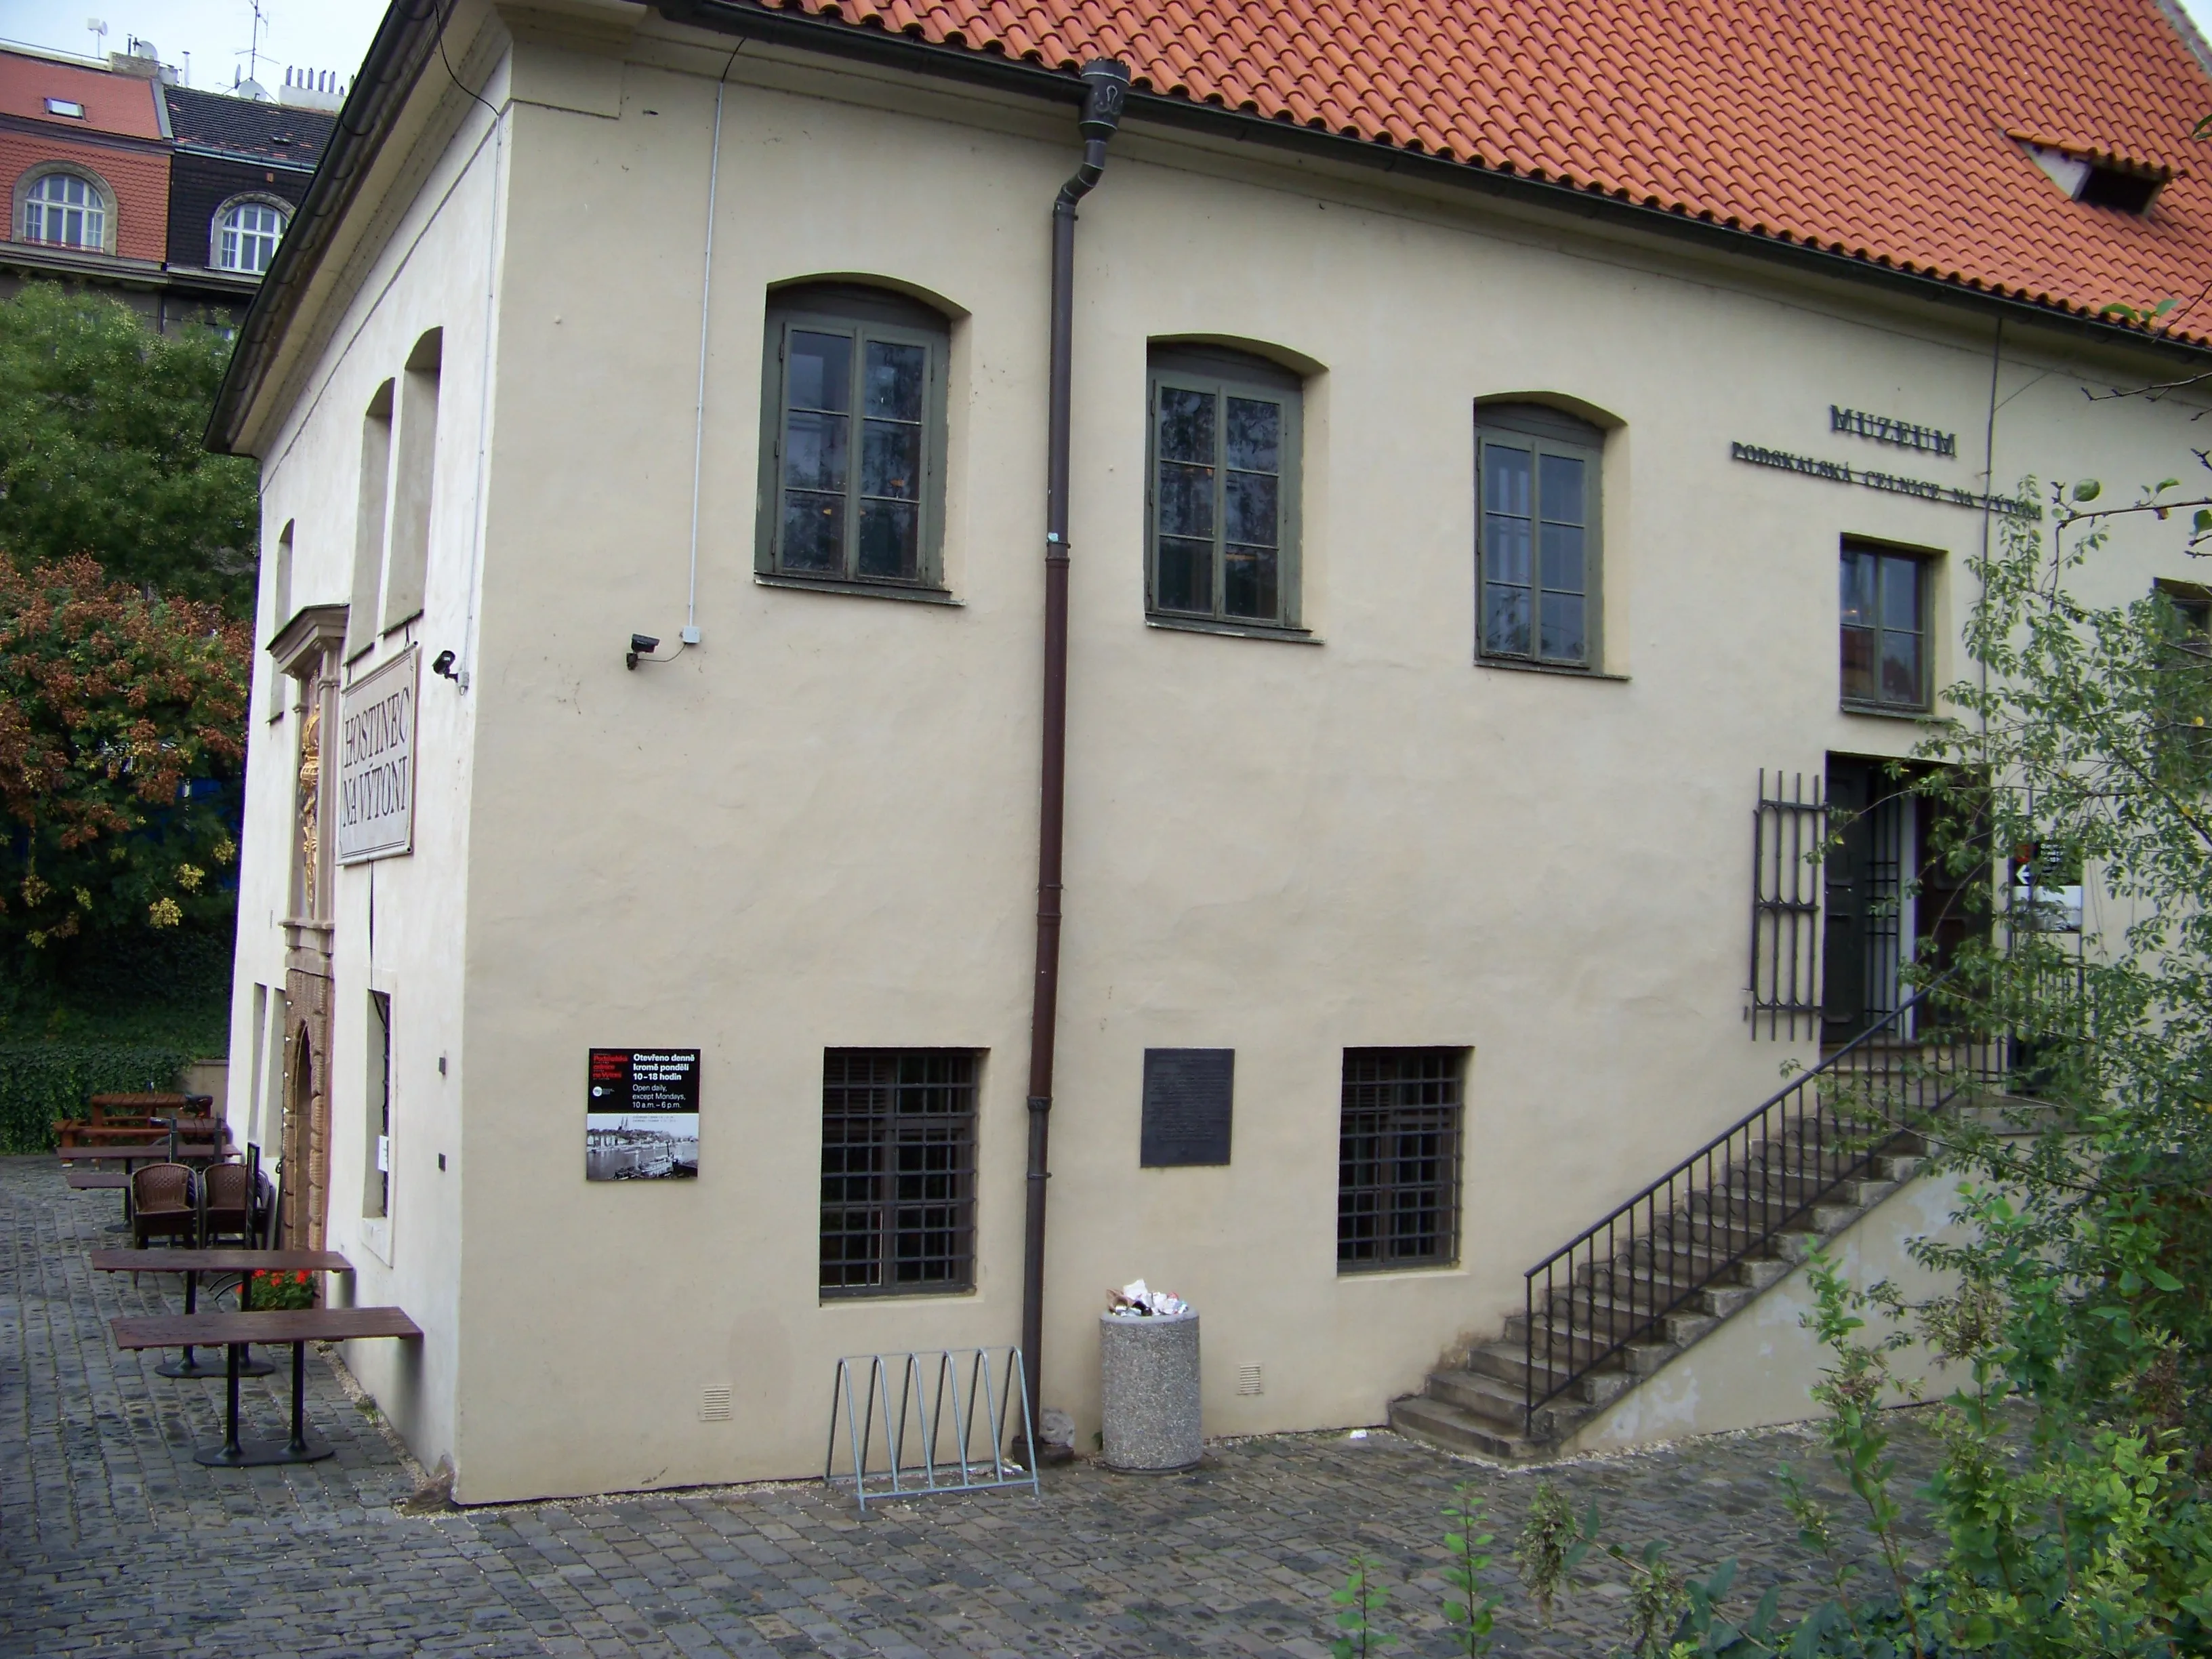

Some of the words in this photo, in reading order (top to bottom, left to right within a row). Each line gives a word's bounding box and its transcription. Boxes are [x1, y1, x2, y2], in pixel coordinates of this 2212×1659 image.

[1830, 404, 1957, 458] MUZEUM
[1732, 441, 1852, 484] PODSKALSKÁ
[1864, 470, 1940, 500] CELNICE
[1953, 488, 1975, 508] NA
[344, 686, 411, 769] HOSTINEC
[342, 778, 358, 827] NA
[359, 755, 408, 823] VÝTONI
[633, 1054, 670, 1062] Otevřeno
[671, 1053, 695, 1062] denně
[633, 1063, 659, 1071] kromě
[660, 1063, 689, 1072] pondělí
[632, 1084, 651, 1092] Open
